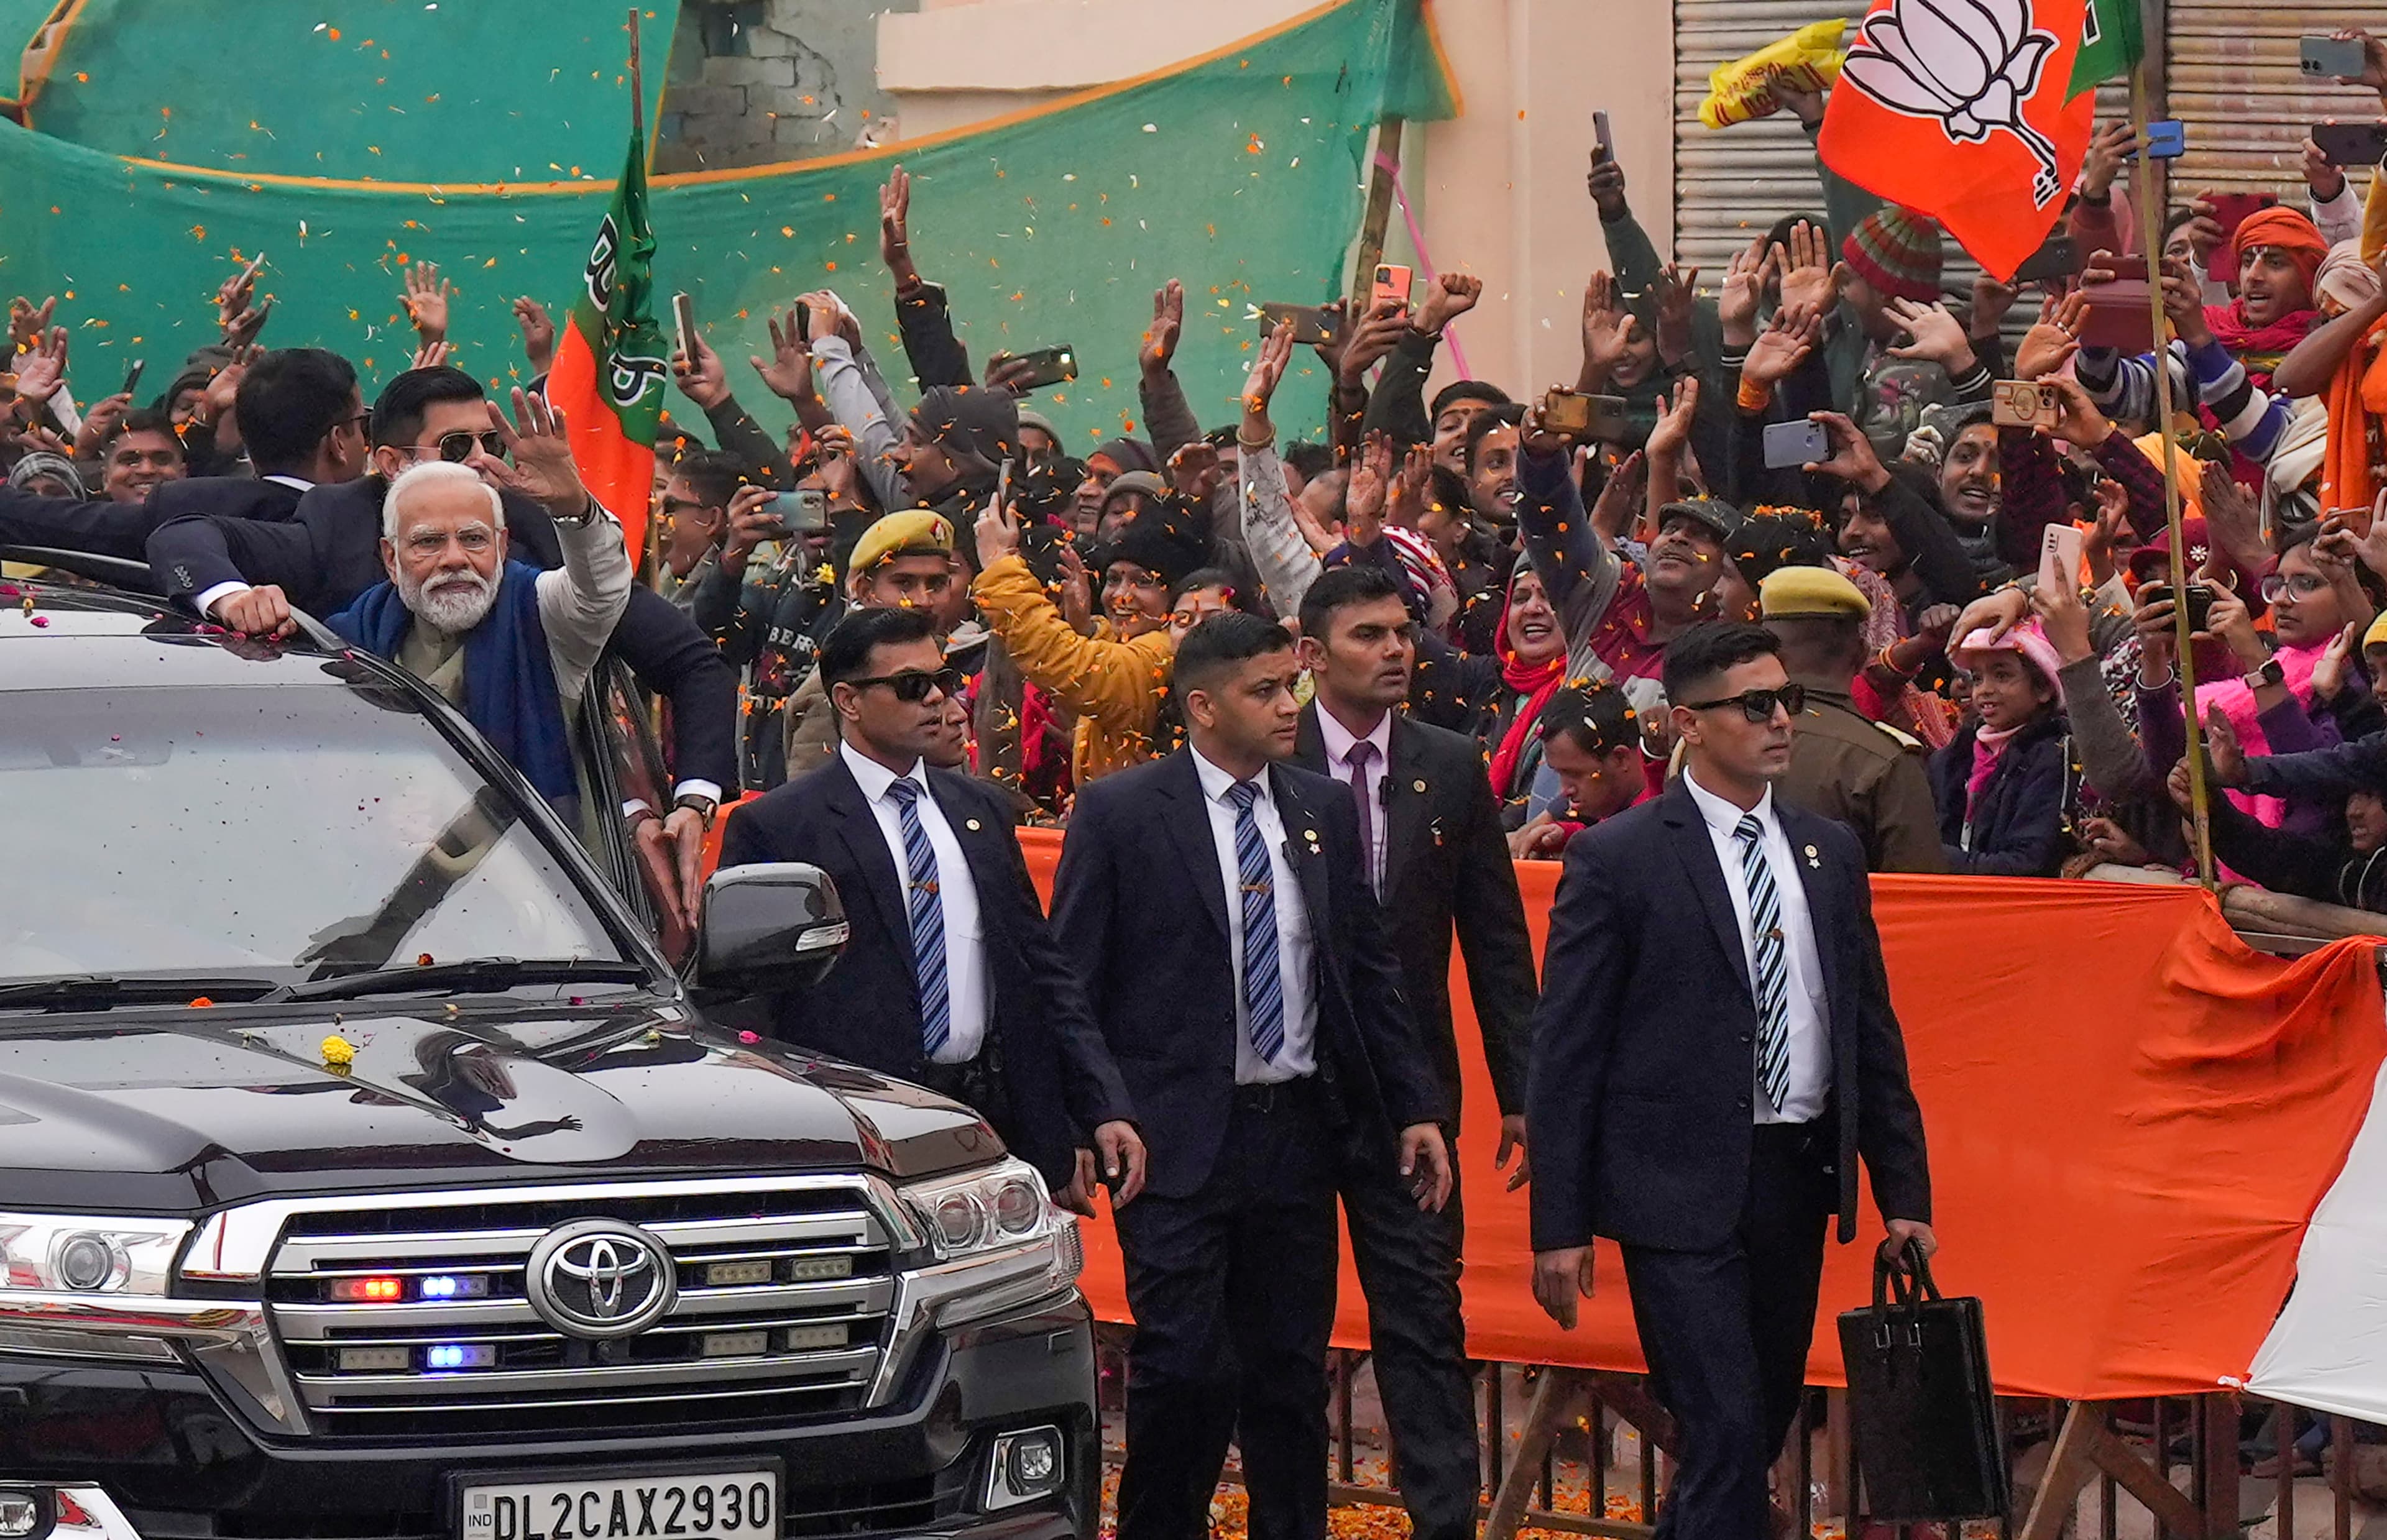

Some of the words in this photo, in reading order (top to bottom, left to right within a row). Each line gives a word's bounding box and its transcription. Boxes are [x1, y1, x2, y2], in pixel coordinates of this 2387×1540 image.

[584, 213, 667, 407] BP
[768, 626, 817, 654] BERR
[468, 1513, 492, 1527] IND
[494, 1482, 770, 1540] DL2CAX2930
